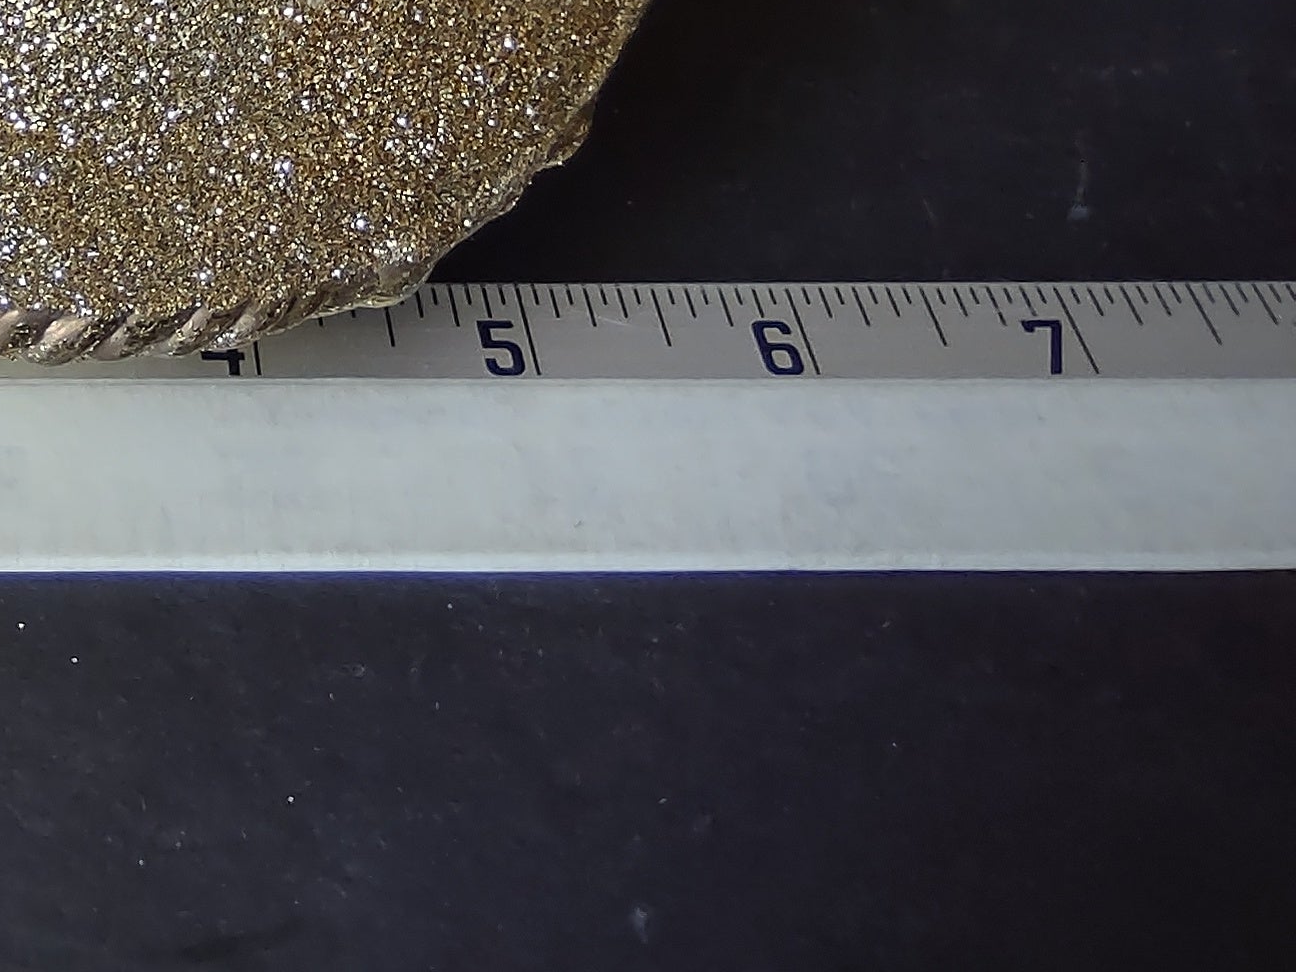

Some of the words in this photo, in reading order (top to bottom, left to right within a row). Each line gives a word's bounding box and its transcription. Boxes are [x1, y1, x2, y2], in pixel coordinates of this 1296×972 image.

[477, 320, 525, 376] 5
[754, 320, 804, 375] 6
[1021, 320, 1062, 375] 7
